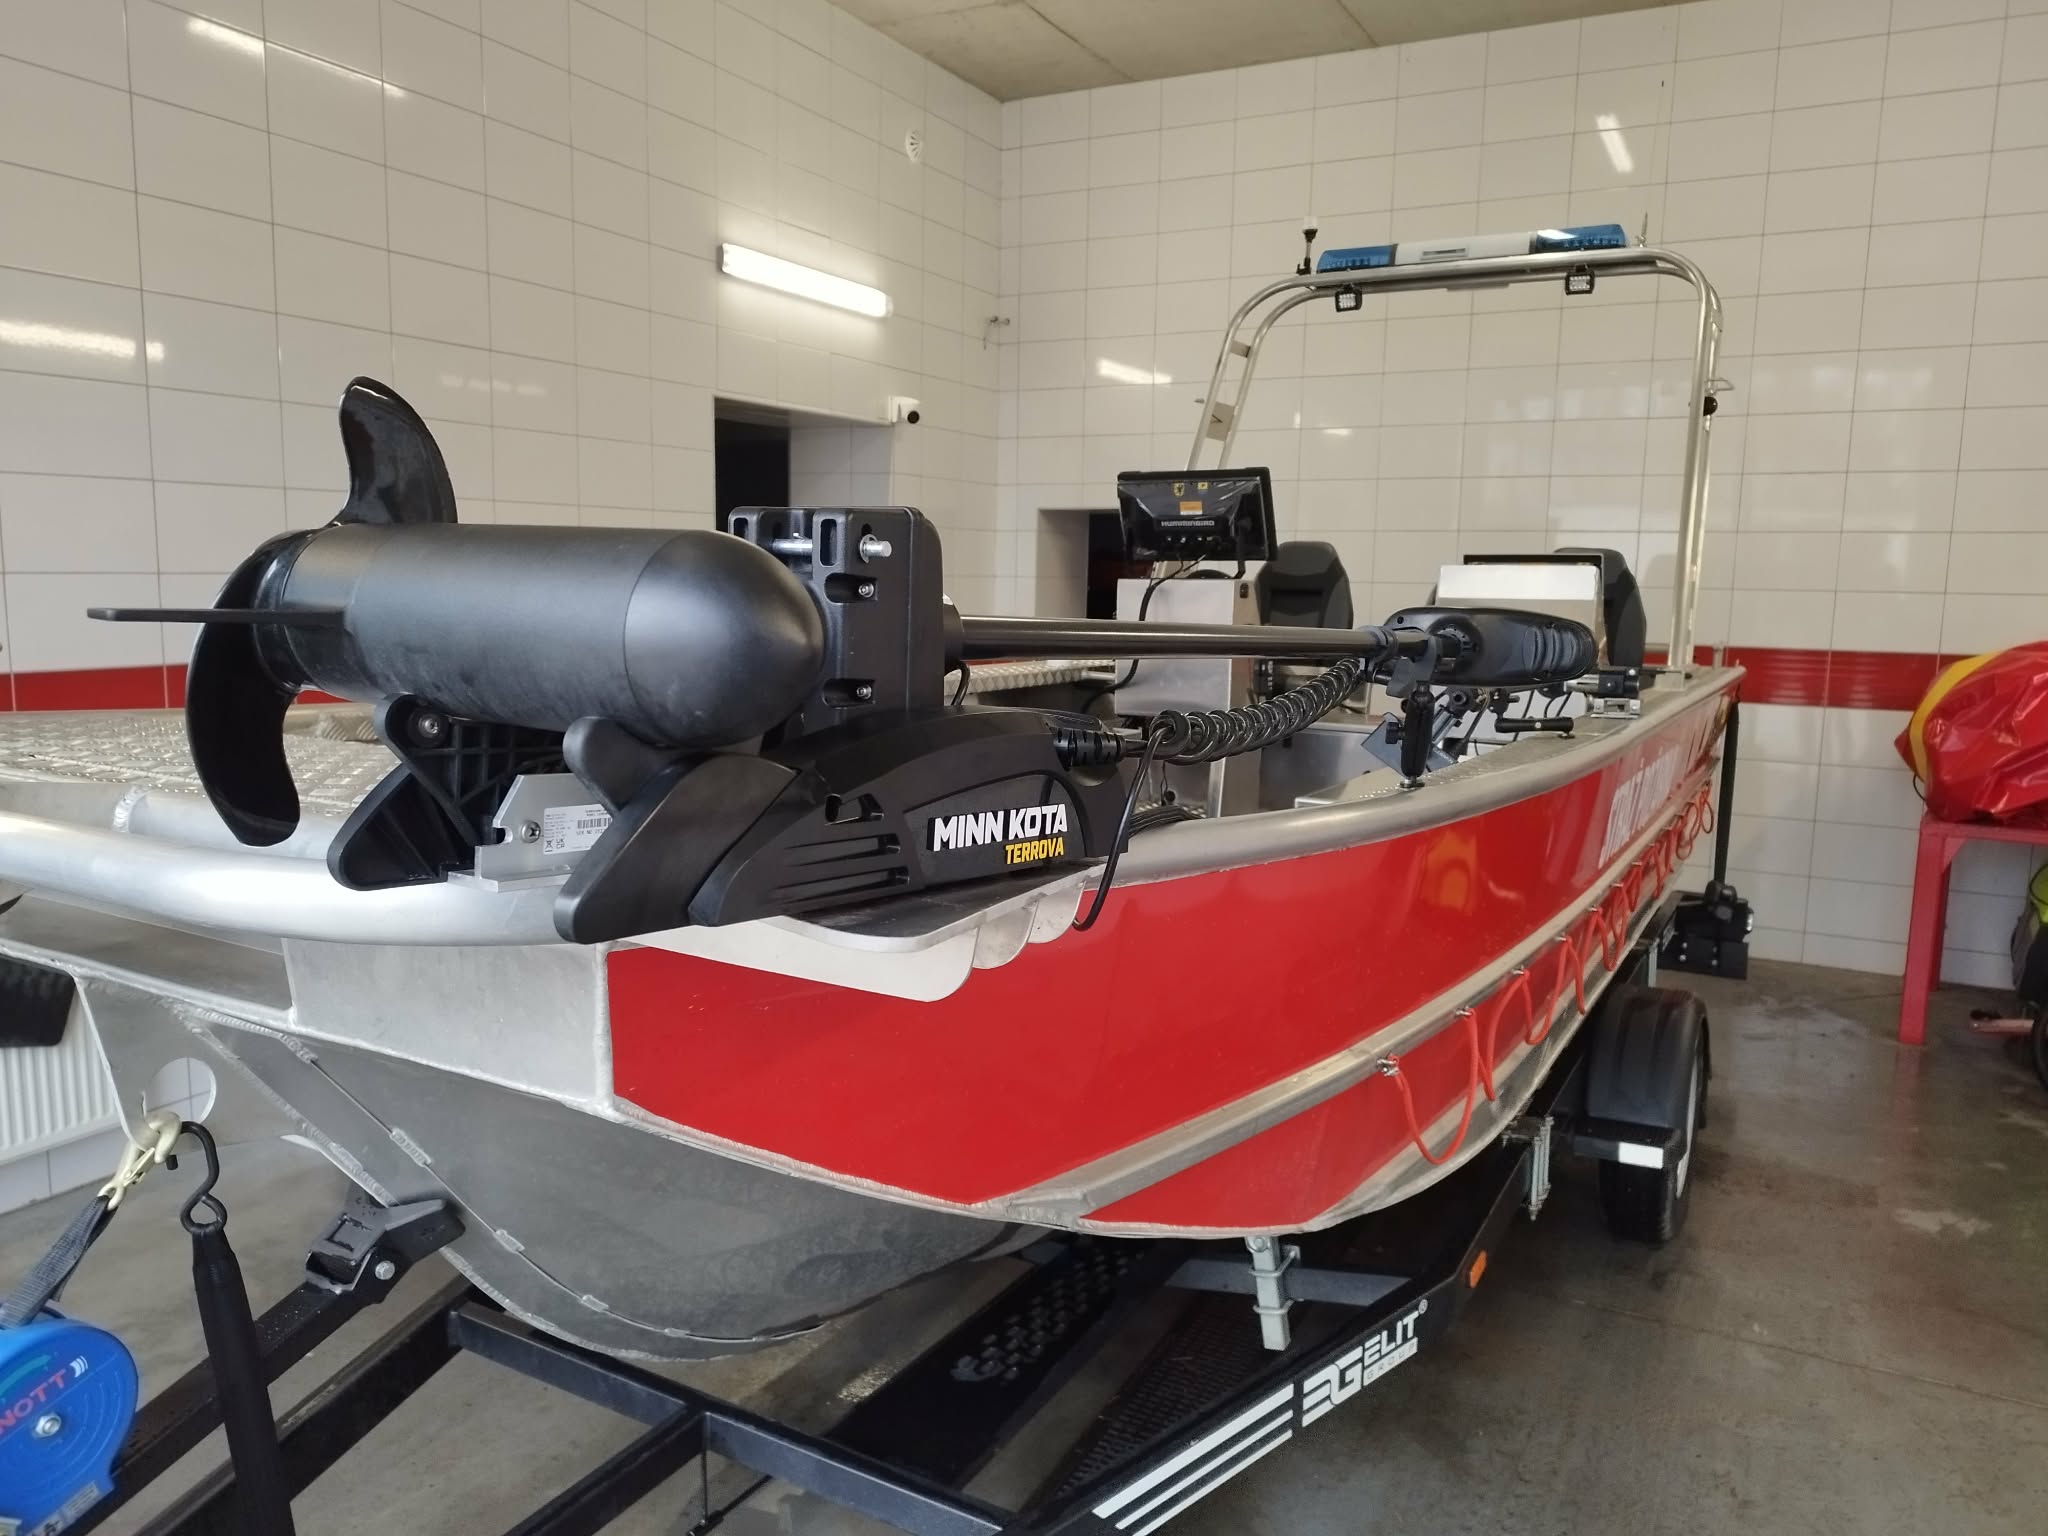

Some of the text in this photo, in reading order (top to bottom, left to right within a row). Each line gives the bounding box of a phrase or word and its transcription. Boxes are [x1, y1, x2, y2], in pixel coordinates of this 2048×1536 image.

[932, 803, 1068, 852] MINN KOTA
[1005, 837, 1064, 865] TERROVA
